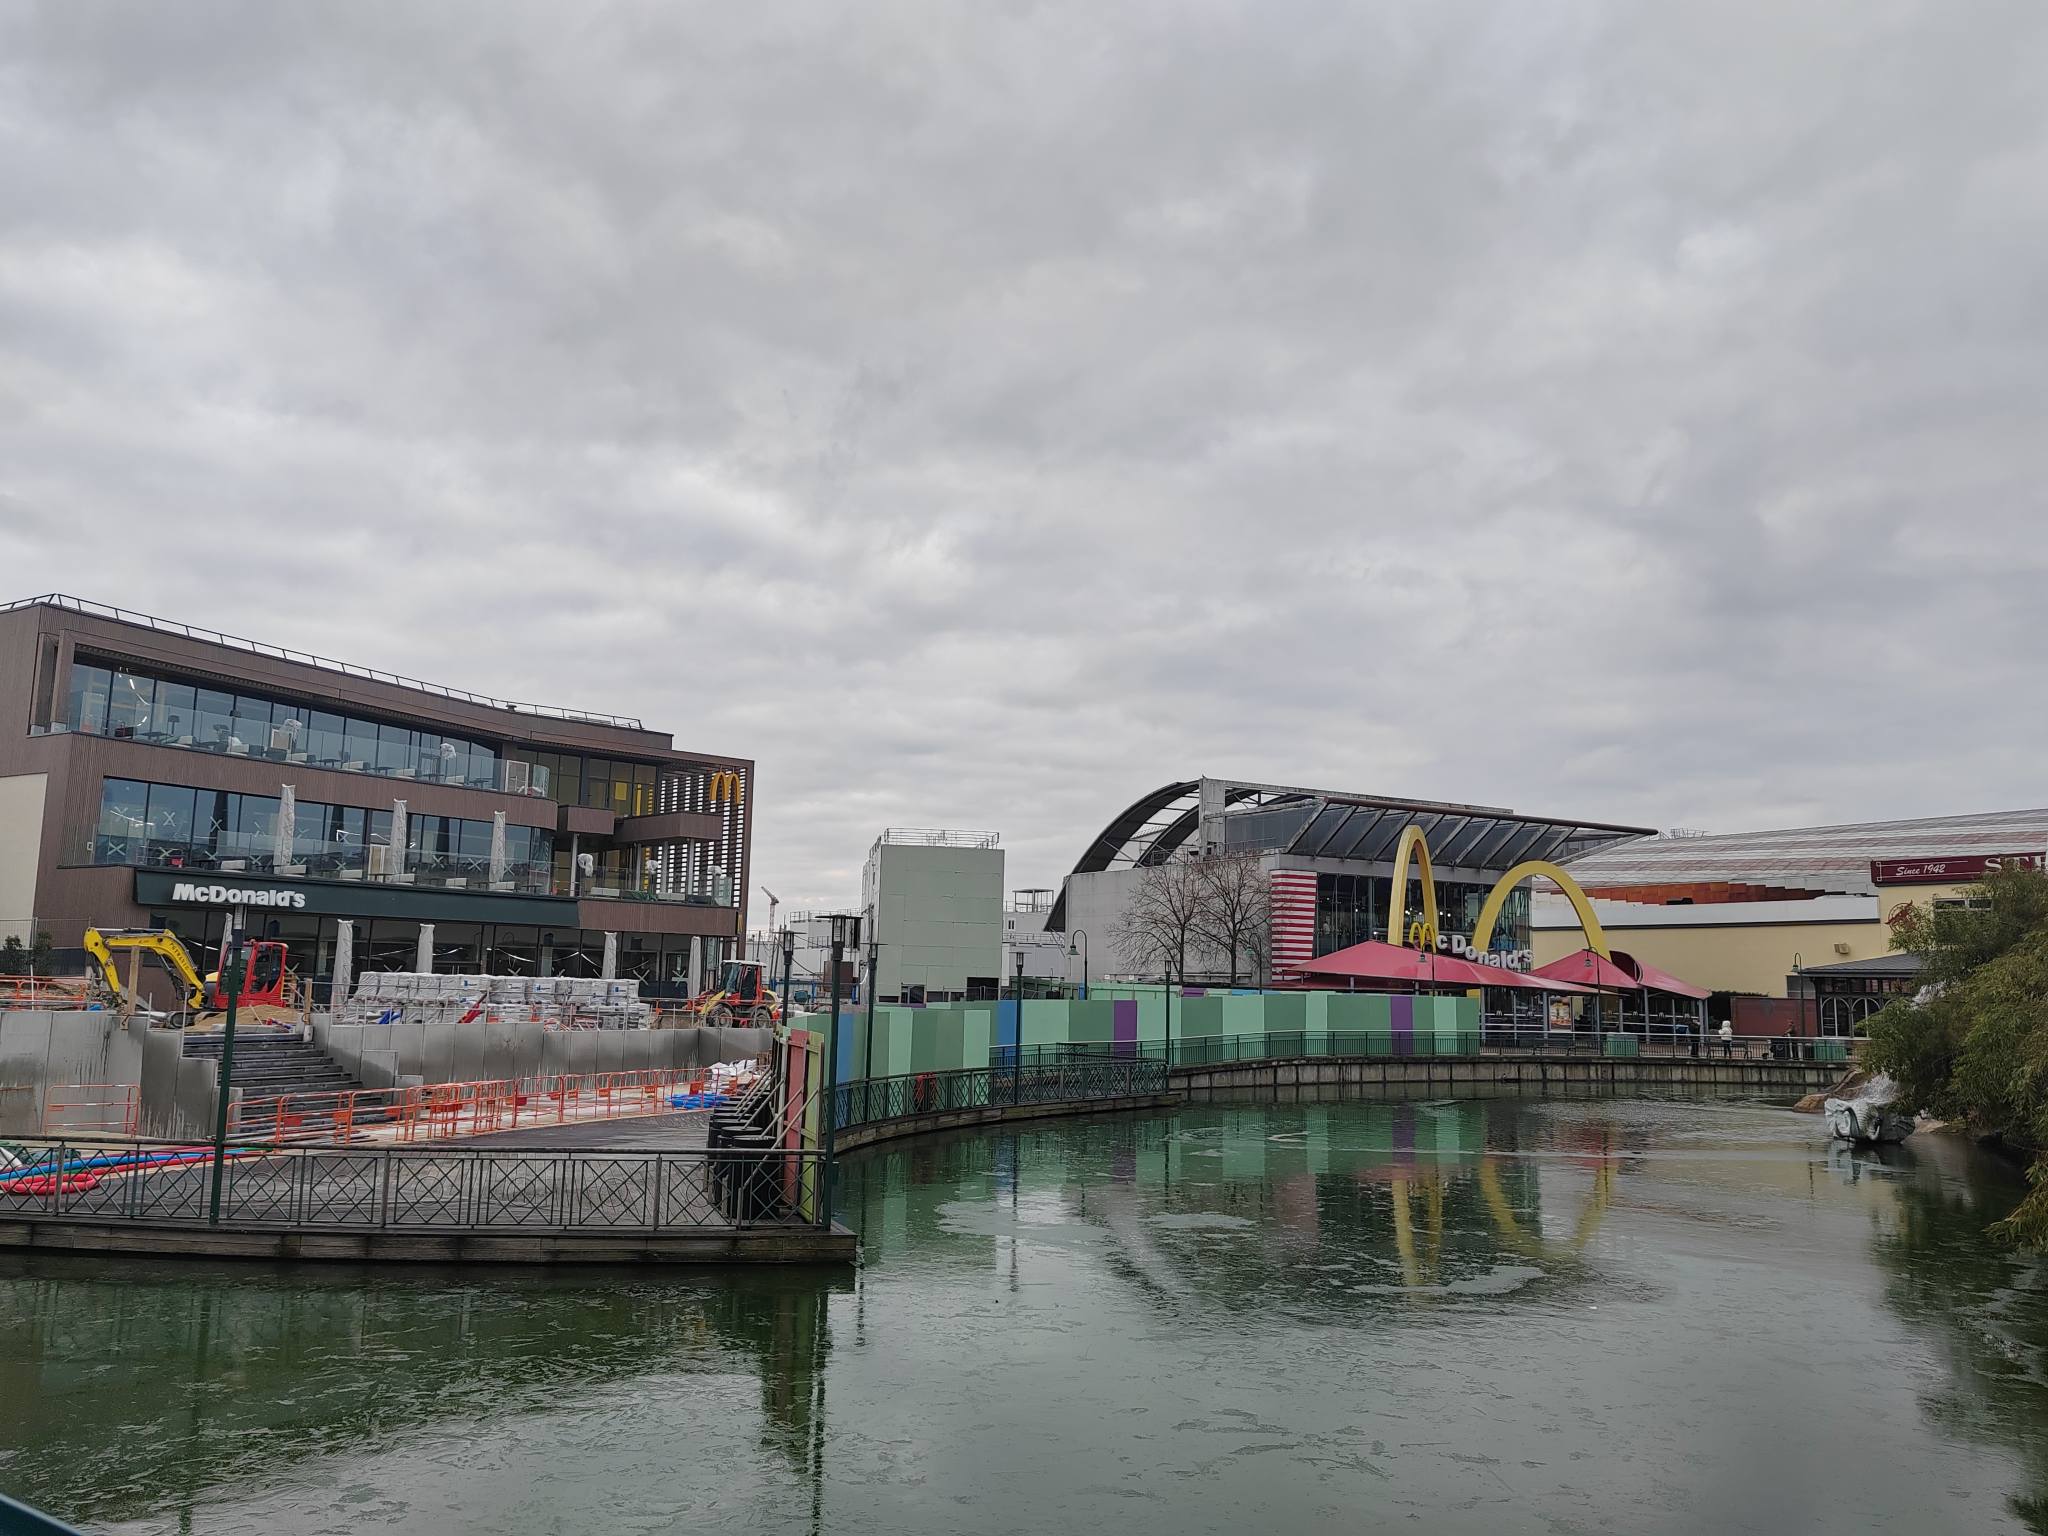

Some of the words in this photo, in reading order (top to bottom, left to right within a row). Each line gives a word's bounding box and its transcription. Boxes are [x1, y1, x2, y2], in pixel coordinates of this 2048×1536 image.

[1895, 866, 1920, 876] Since
[1923, 864, 1946, 874] 1942
[172, 883, 306, 908] McDonald's
